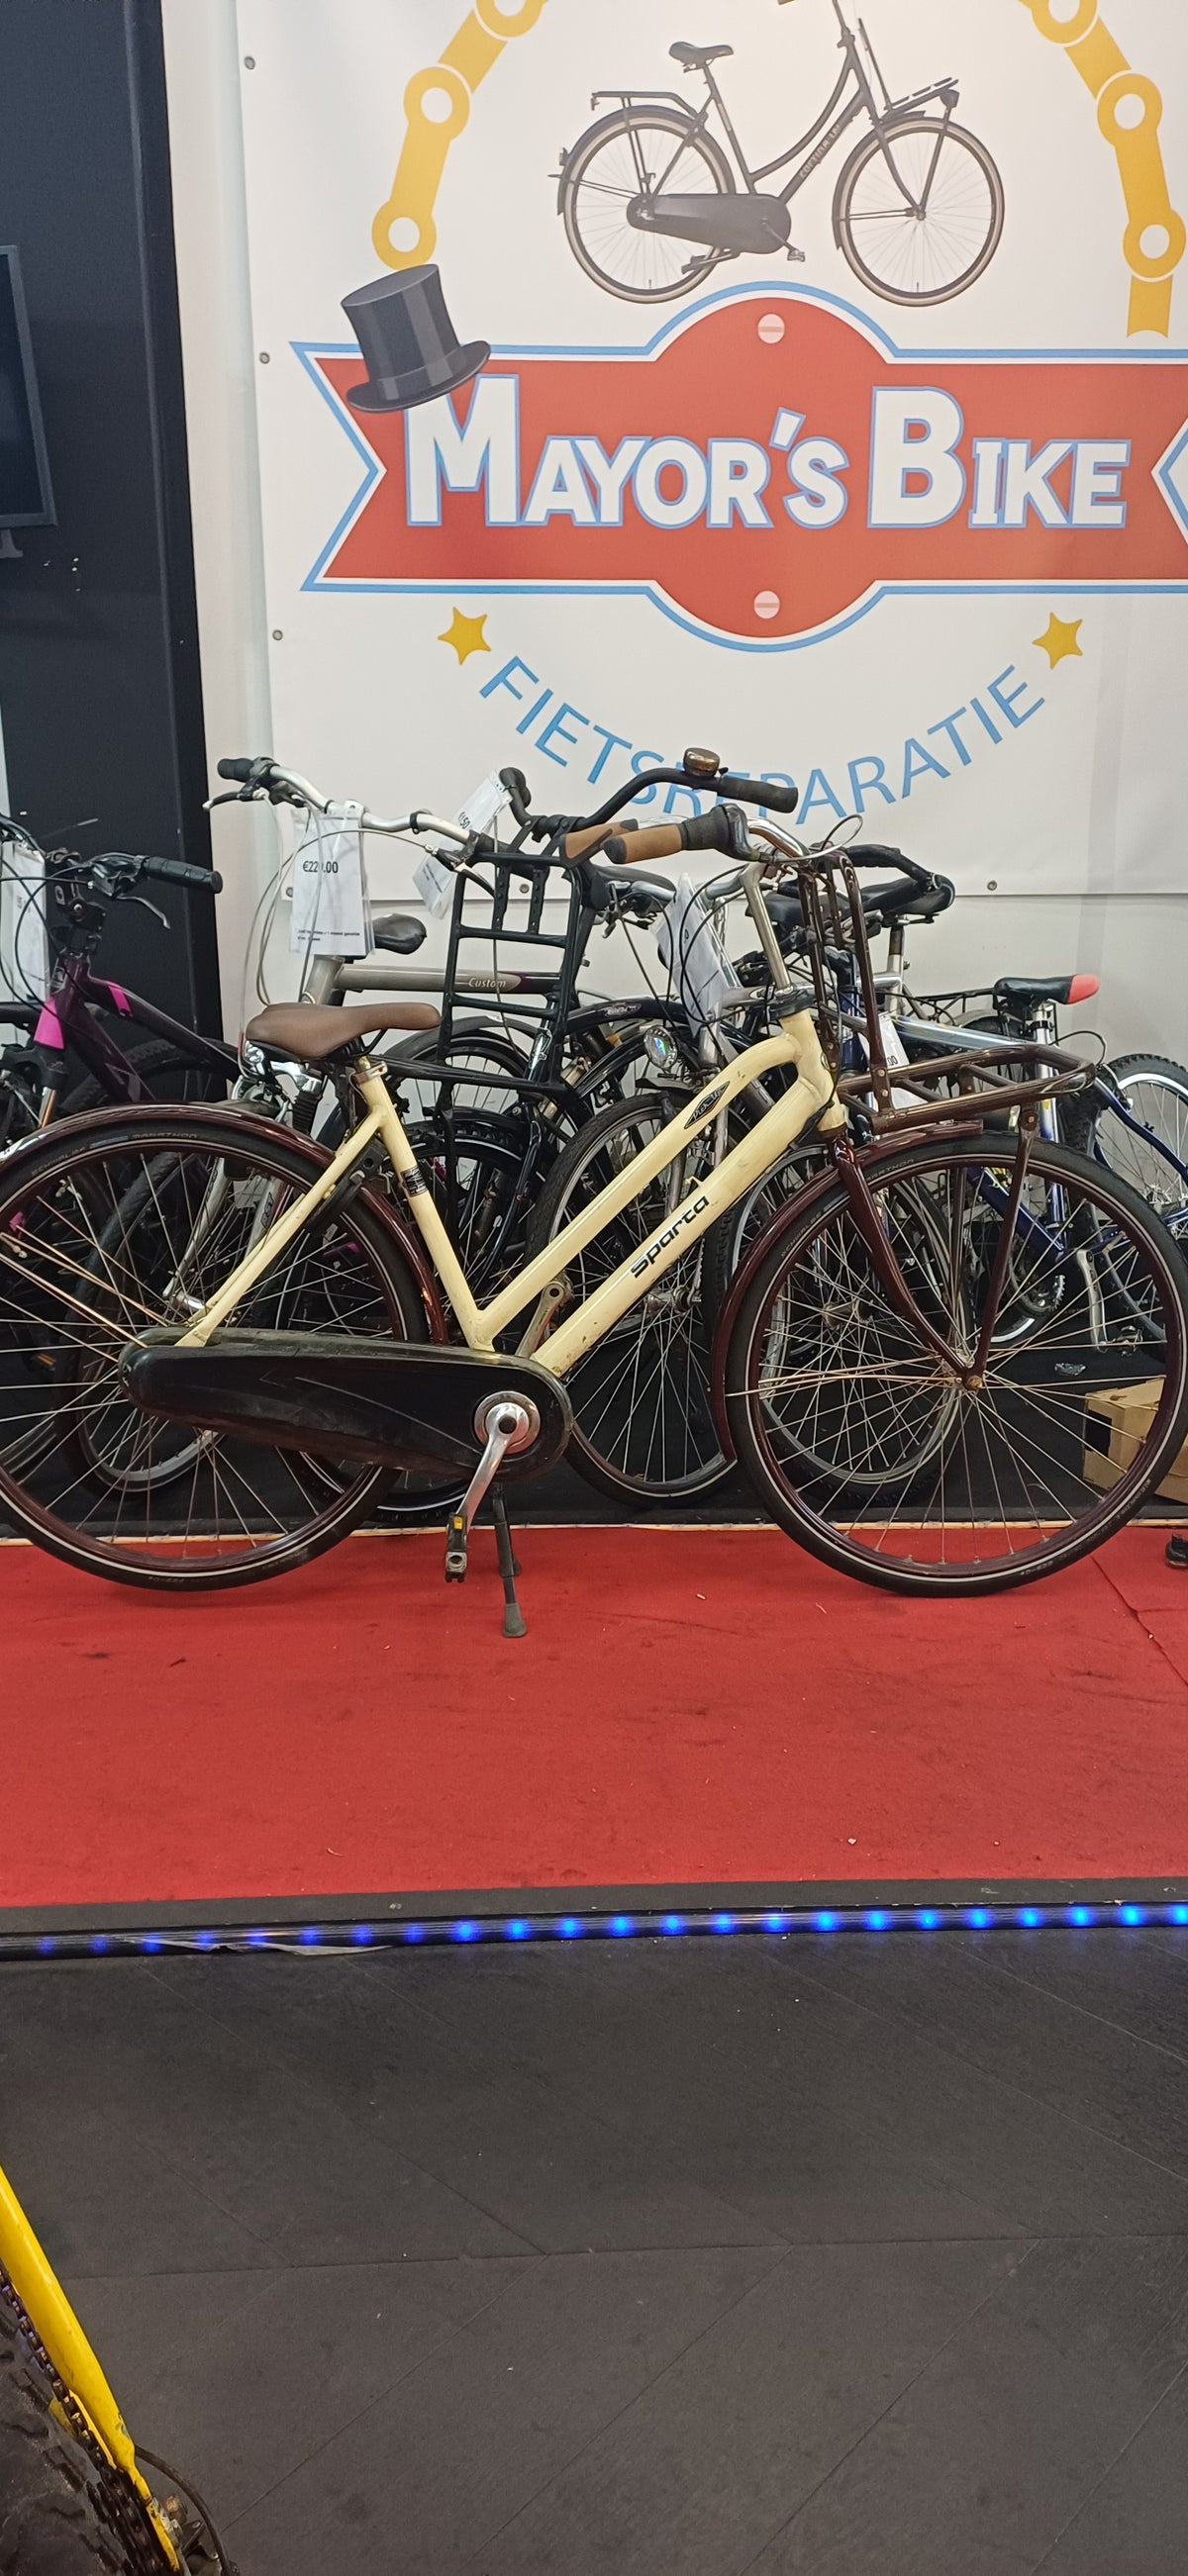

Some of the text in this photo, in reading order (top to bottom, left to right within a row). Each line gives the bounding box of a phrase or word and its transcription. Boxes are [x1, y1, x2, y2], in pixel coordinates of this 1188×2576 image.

[404, 374, 1132, 529] MAYOR'S BIKE
[468, 977, 507, 989] Custom
[866, 1158, 915, 1181] ARATHON
